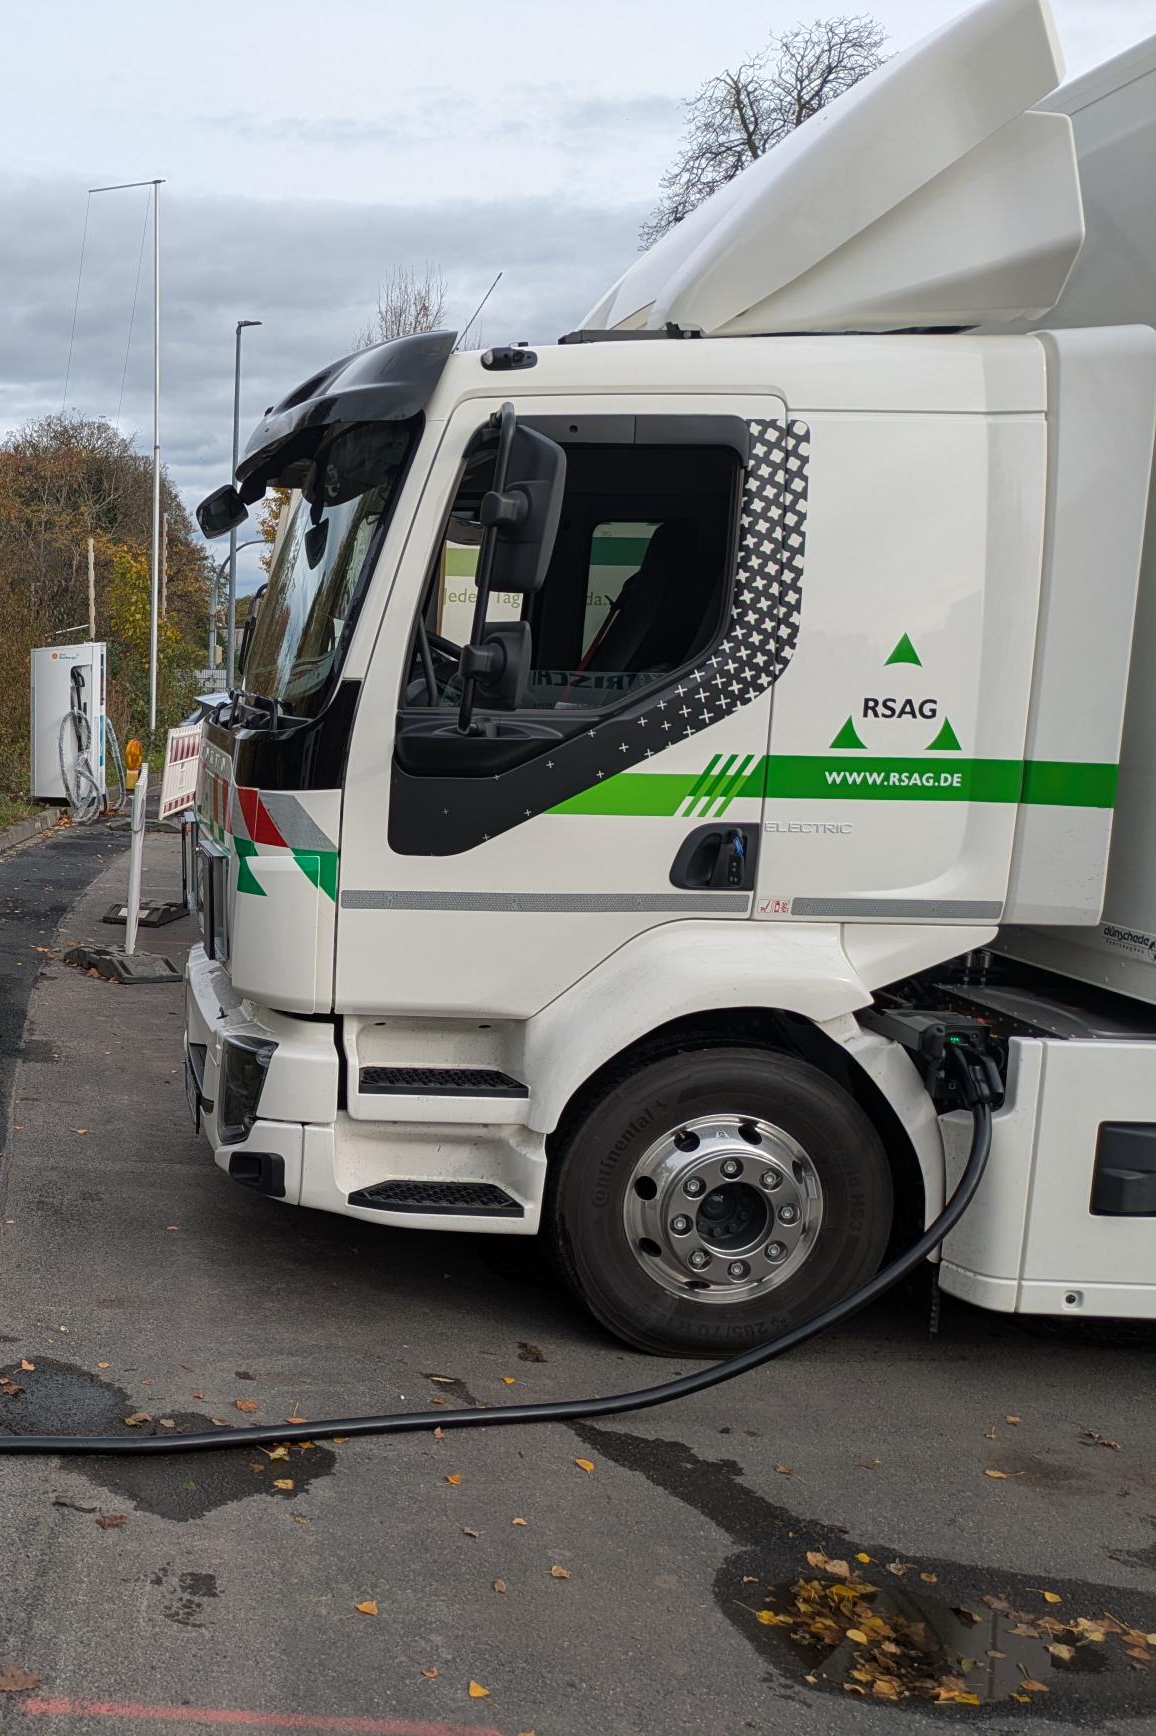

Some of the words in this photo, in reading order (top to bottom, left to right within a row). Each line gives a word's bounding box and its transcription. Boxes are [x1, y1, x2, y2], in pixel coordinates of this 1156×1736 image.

[444, 588, 476, 604] Jede
[862, 698, 938, 719] RSAG
[825, 771, 962, 787] WWW.RSAG.DE
[764, 821, 853, 834] ELECTRIC
